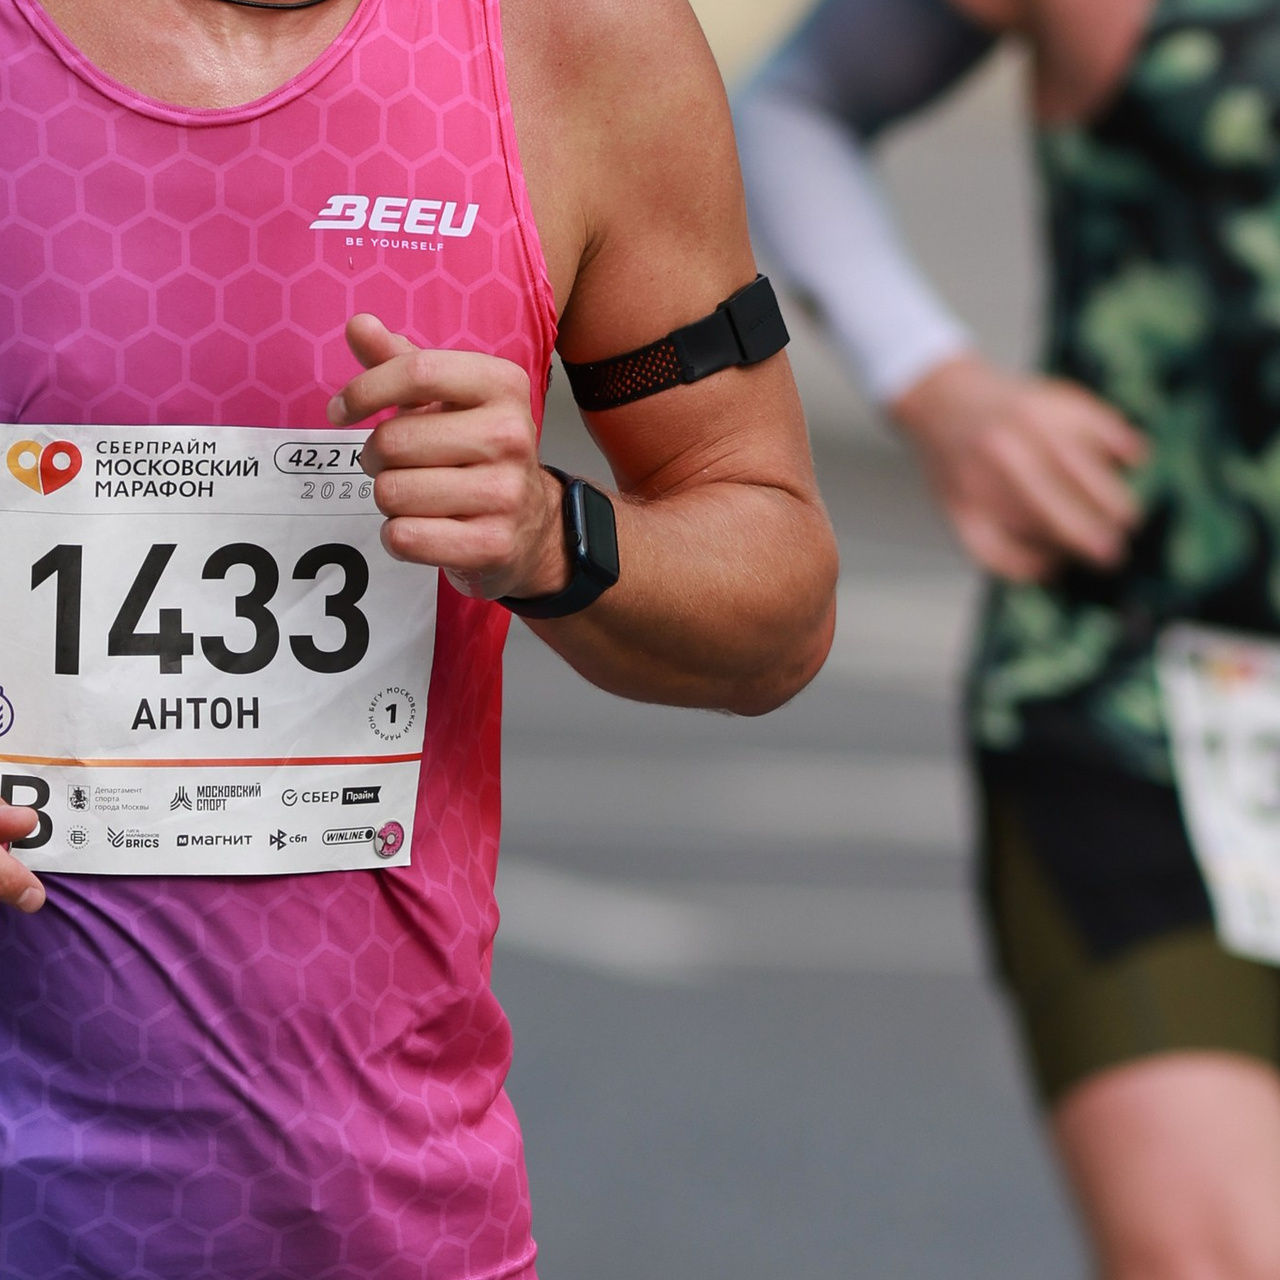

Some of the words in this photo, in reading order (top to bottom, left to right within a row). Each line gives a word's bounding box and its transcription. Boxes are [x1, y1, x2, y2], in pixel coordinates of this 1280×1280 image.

[309, 195, 480, 238] BEEU
[345, 237, 363, 247] BE
[371, 238, 444, 252] YOURSELF
[96, 438, 217, 455] СБЕРПРАЙМ
[95, 456, 259, 477] МОСКОВСКИЙ
[288, 449, 340, 470] 42,2
[95, 480, 214, 498] МАРАФОН
[300, 481, 372, 499] 2026
[30, 542, 370, 675] 1433
[368, 691, 384, 712] БЕГУ
[386, 686, 416, 734] МОСКОВСКИЙ
[131, 697, 260, 730] АНТОН
[385, 703, 397, 724] 1
[368, 715, 401, 741] МАРАФОН
[94, 786, 142, 795] Департамент
[197, 782, 262, 798] МОСКОВСКИЙ
[301, 791, 339, 803] СБЕР
[346, 790, 375, 802] Прайм
[94, 804, 120, 812] города
[121, 803, 150, 811] Москвы
[197, 799, 227, 811] СПОРТ
[125, 839, 160, 848] BRICS
[191, 834, 253, 846] магнит
[289, 834, 308, 843] сбп
[326, 830, 365, 842] WINLINE
